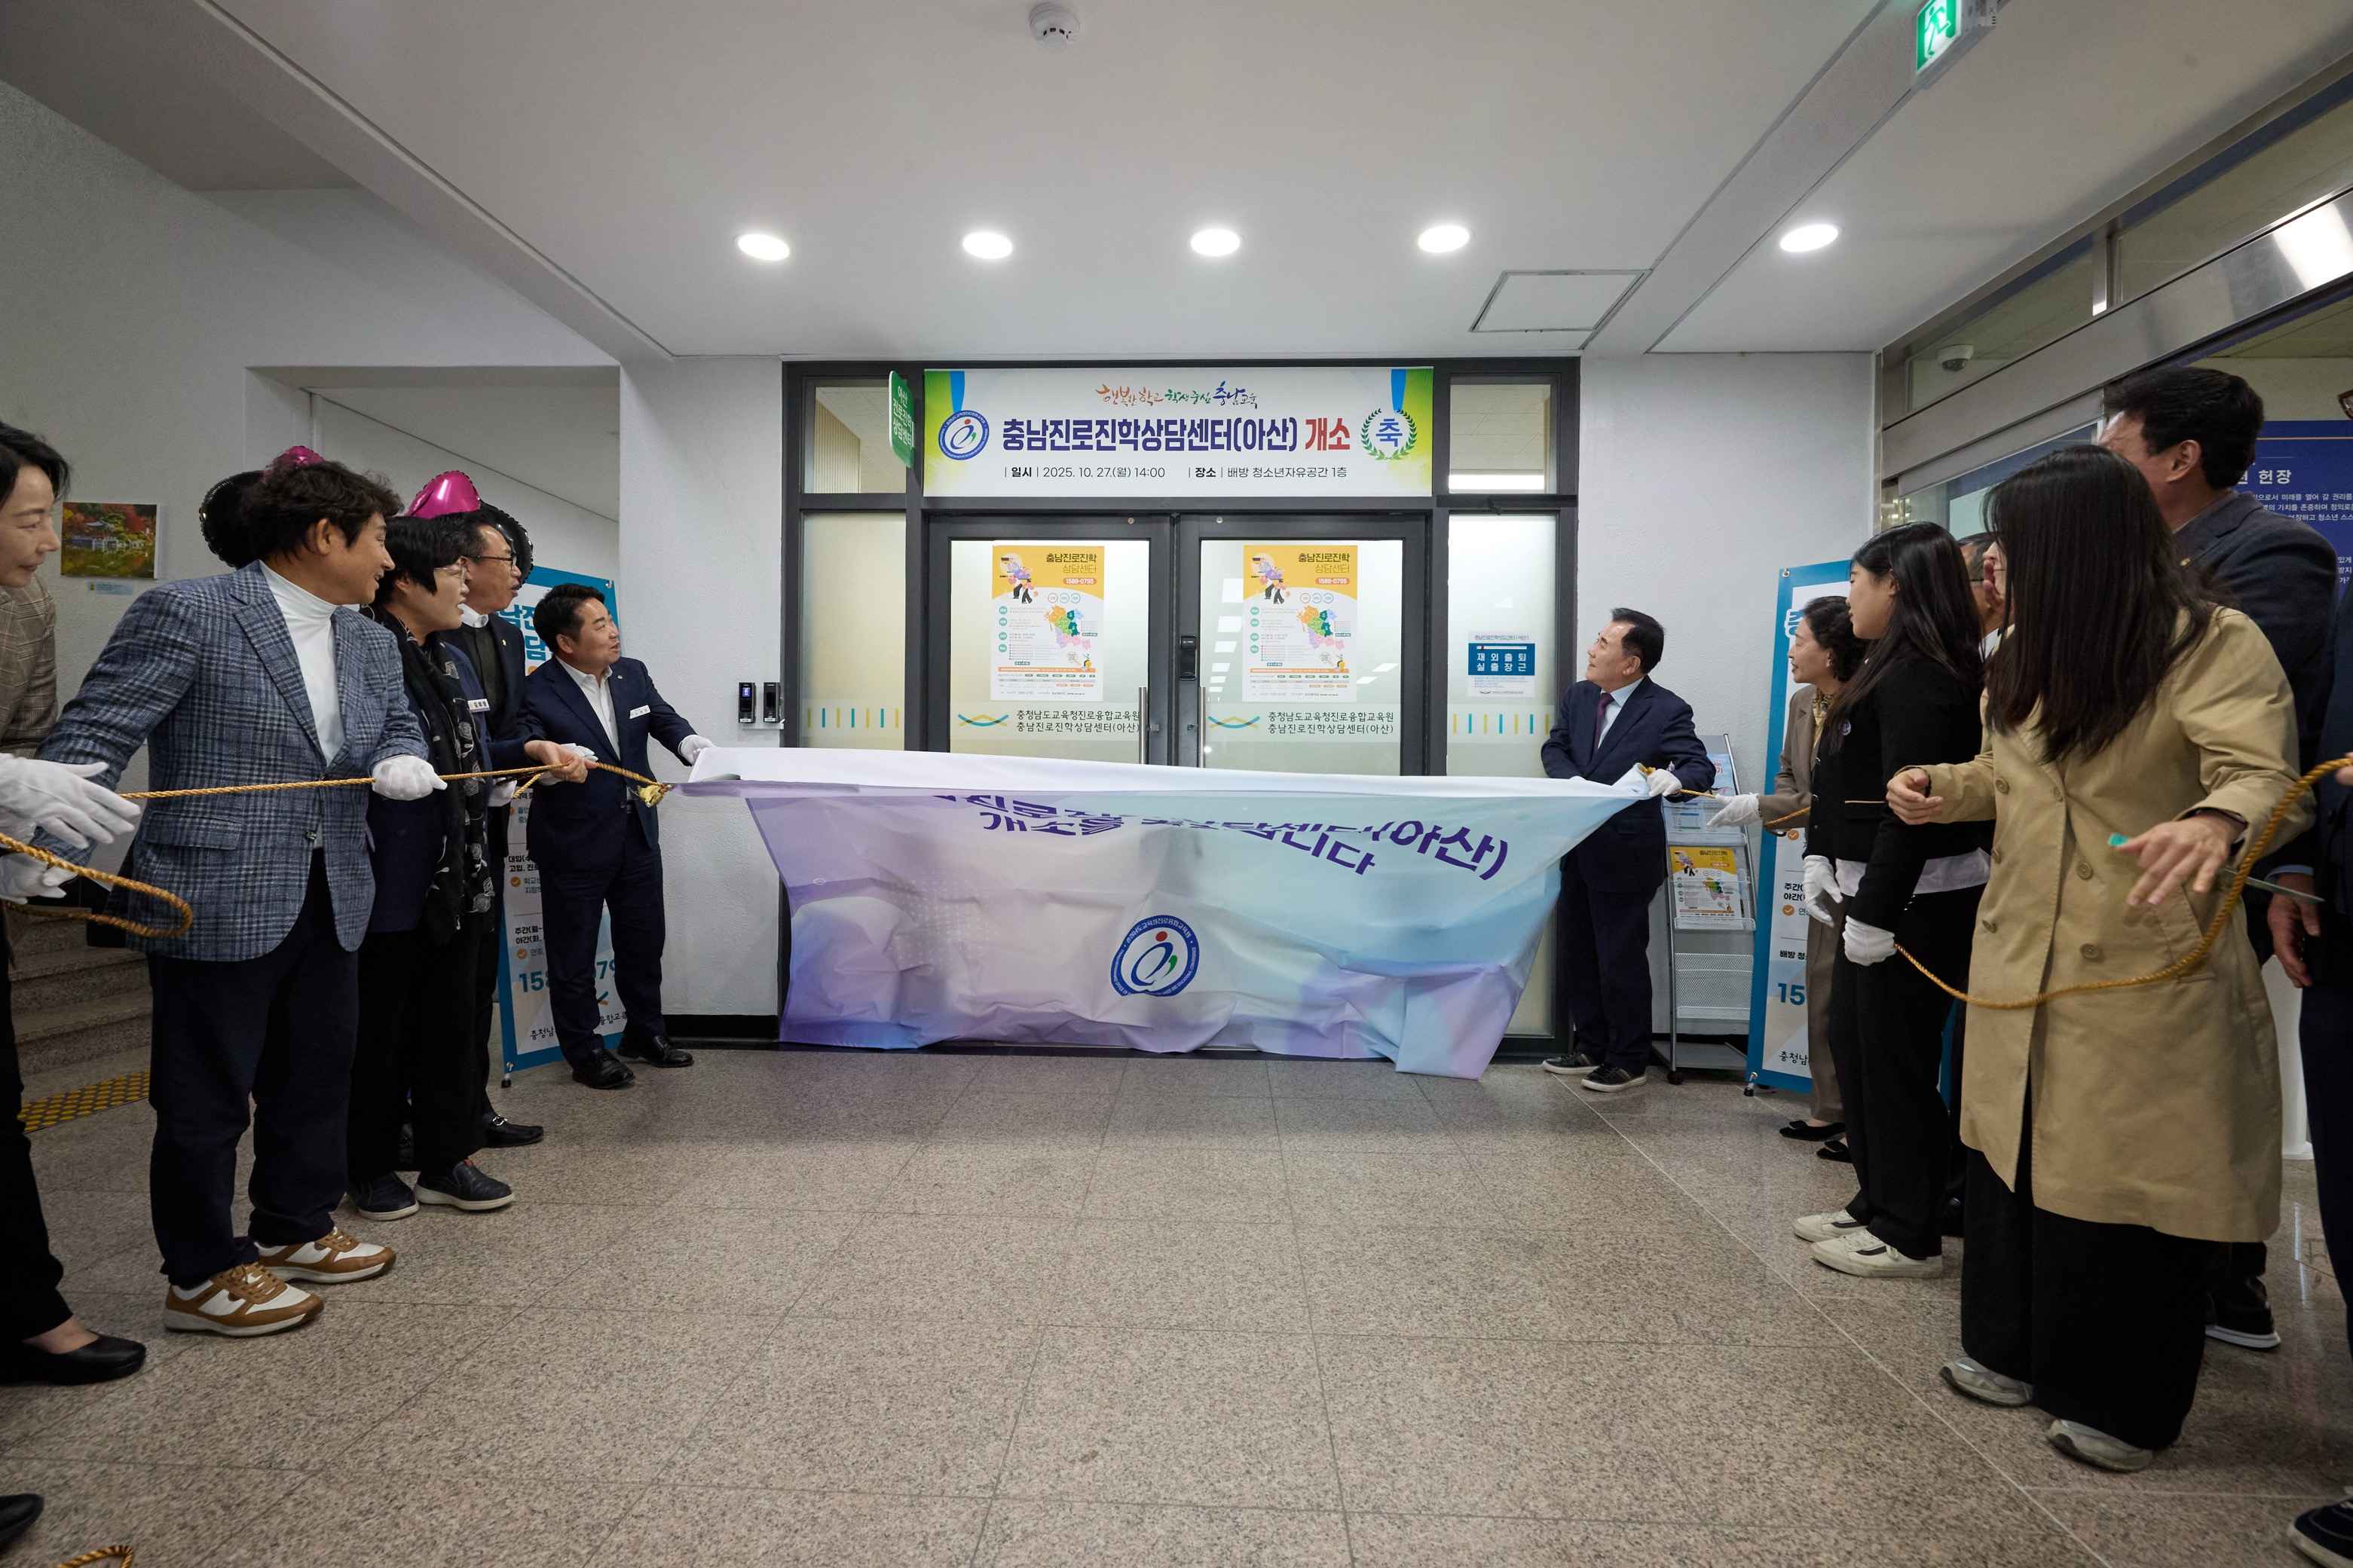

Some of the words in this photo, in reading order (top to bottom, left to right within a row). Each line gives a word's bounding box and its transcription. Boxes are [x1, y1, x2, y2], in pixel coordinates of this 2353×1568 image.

[1002, 417, 1298, 452] 충남진로진학상담센터(아산)
[1305, 417, 1351, 451] 개소
[1375, 418, 1403, 448] 축
[1011, 466, 1032, 478] 일시
[1043, 467, 1076, 478] 2025.
[1079, 467, 1094, 478] 10.
[1134, 467, 1166, 478] 14:00
[1195, 466, 1216, 478] 장소
[1228, 467, 1249, 478] 배방
[1252, 467, 1328, 478] 청소년자유공간
[1331, 467, 1348, 478] 1층
[2259, 469, 2292, 484] 헌장
[1017, 710, 1140, 721] 충청남도교육청진로융합교육원
[1268, 711, 1394, 723] 충청남도교육청진로융합교육원
[1268, 723, 1394, 735] 충남진로진학상담센터(아산)
[1797, 952, 1808, 960] 청
